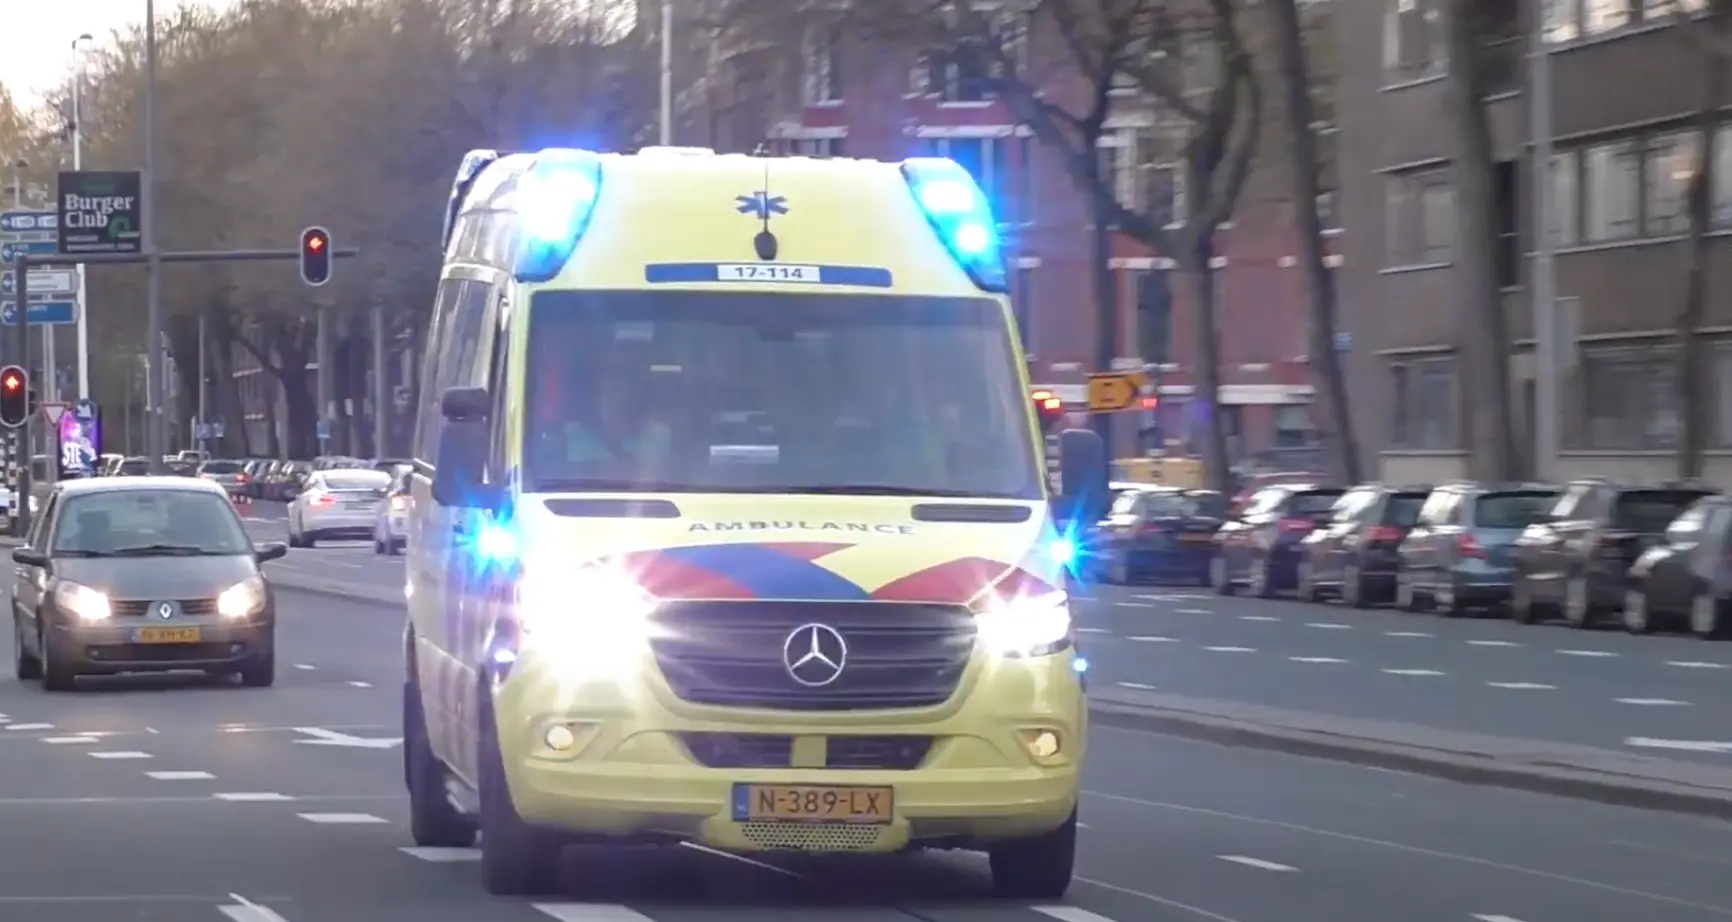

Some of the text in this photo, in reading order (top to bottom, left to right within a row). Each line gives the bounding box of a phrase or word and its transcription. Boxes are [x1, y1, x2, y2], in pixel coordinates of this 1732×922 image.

[65, 194, 134, 214] Burger
[65, 211, 108, 228] Club
[735, 266, 804, 279] 17-114
[688, 520, 916, 536] AMBULANCE
[759, 788, 880, 815] N-389-LX
